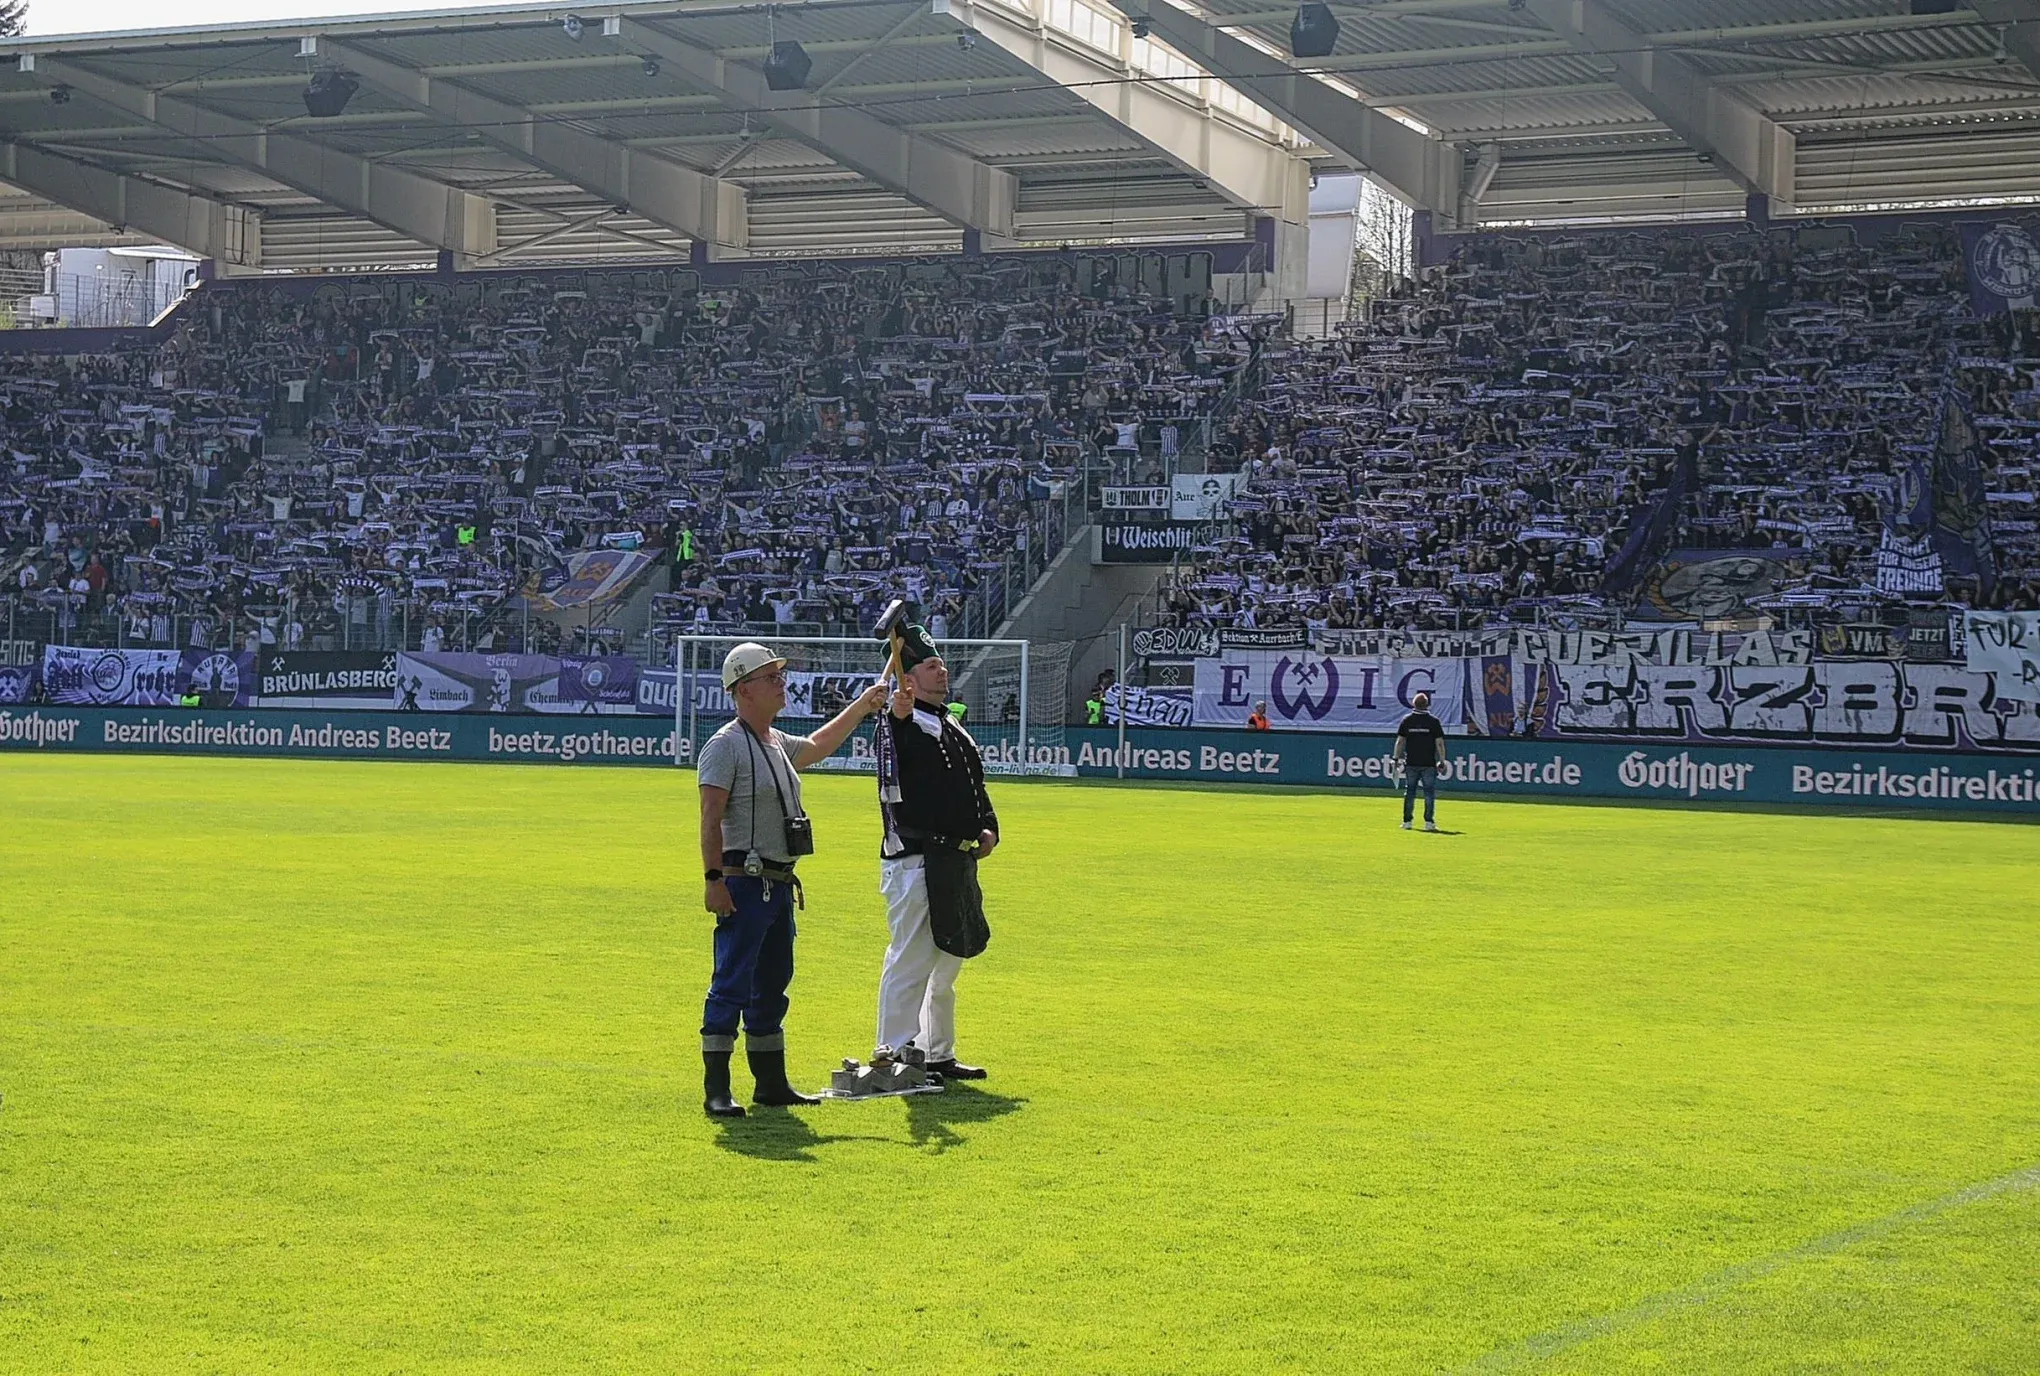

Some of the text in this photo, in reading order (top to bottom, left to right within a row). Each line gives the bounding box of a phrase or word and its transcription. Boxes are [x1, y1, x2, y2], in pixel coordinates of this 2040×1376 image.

[1908, 627, 1946, 641] JETZT
[263, 670, 398, 694] BRÜNLASBERG
[104, 717, 451, 751] Bezirksdirektion Andreas Beetz
[489, 727, 691, 760] beetz.gothaer.de
[1077, 740, 1192, 770] Andreas
[1200, 746, 1280, 774] Beetz
[1618, 751, 1754, 797] Gothaer
